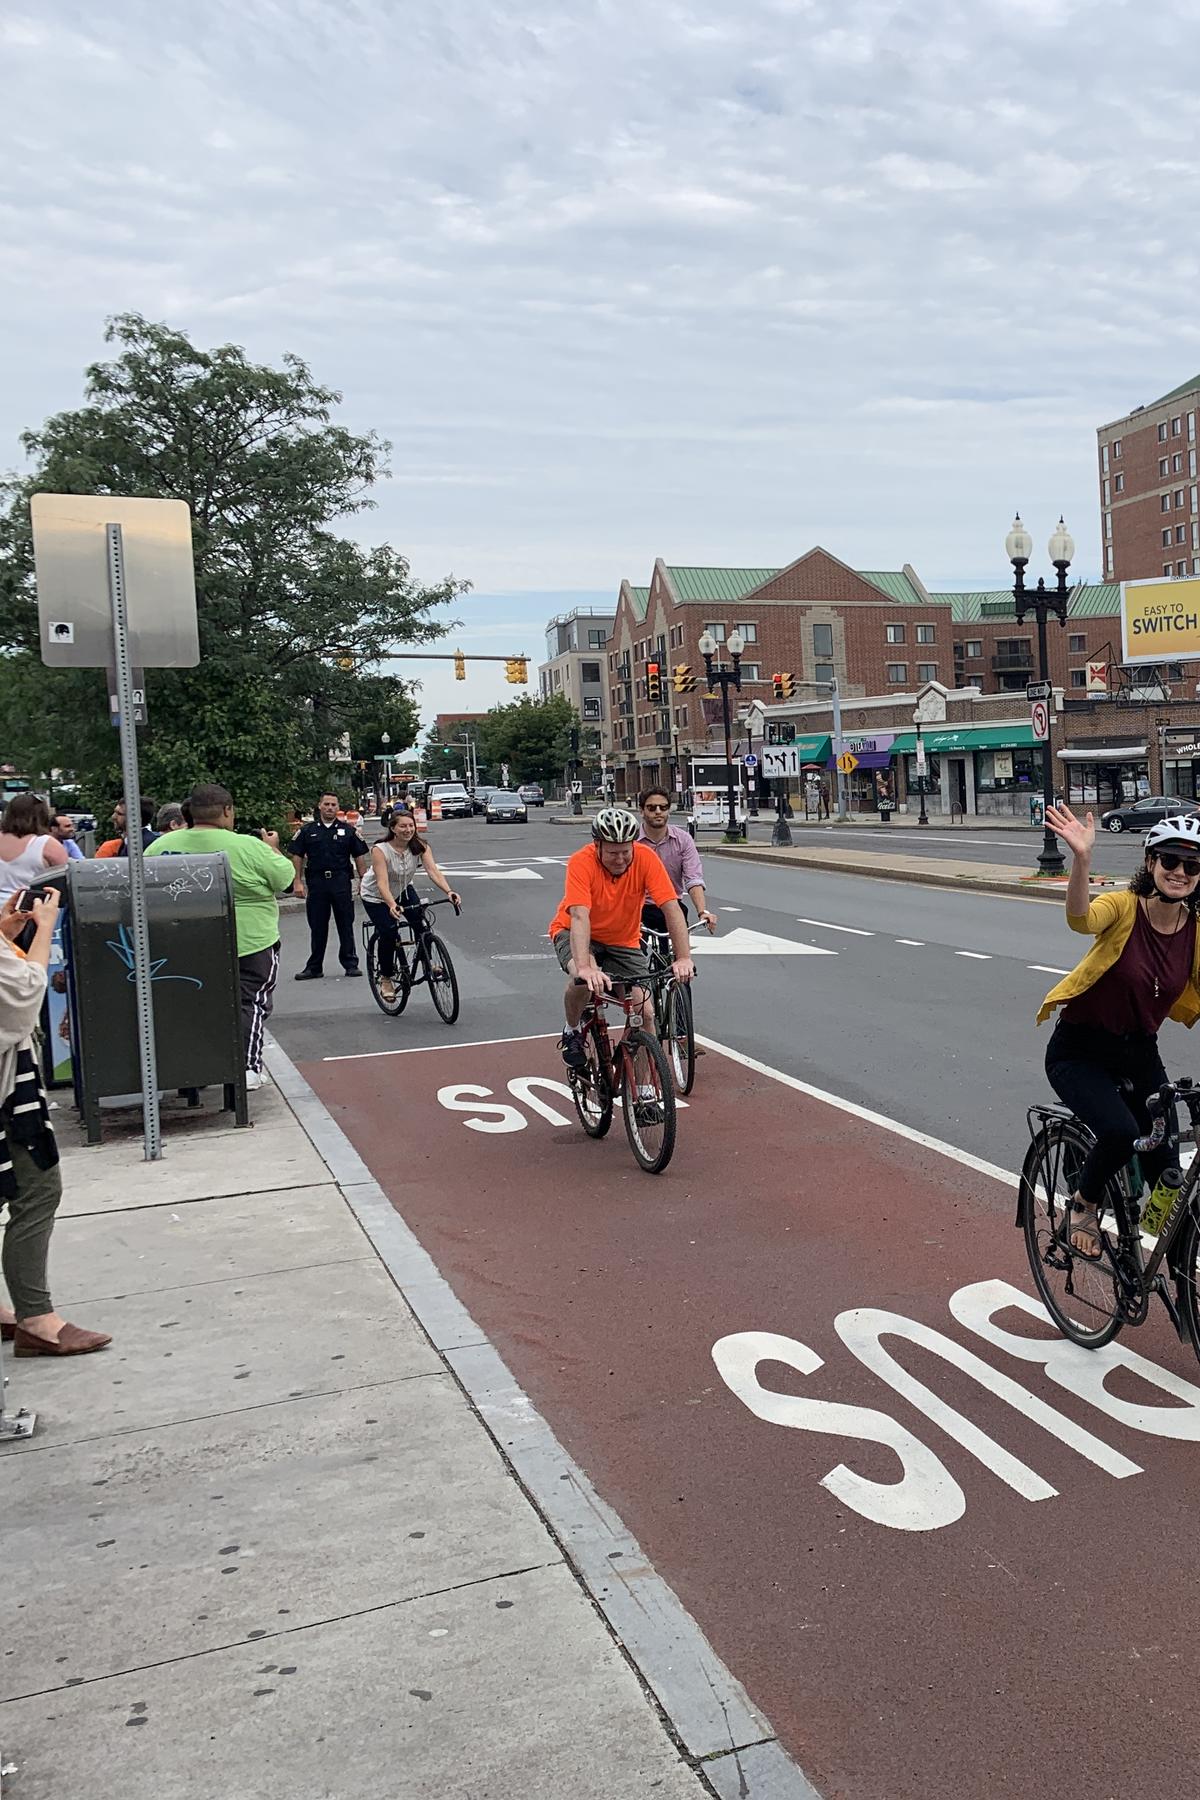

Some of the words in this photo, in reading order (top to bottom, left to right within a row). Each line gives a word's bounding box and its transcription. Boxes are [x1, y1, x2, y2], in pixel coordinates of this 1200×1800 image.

[1144, 605, 1168, 616] EASY
[1170, 603, 1184, 613] TO
[1133, 614, 1197, 634] SWITCH
[1176, 743, 1200, 755] WHOLE
